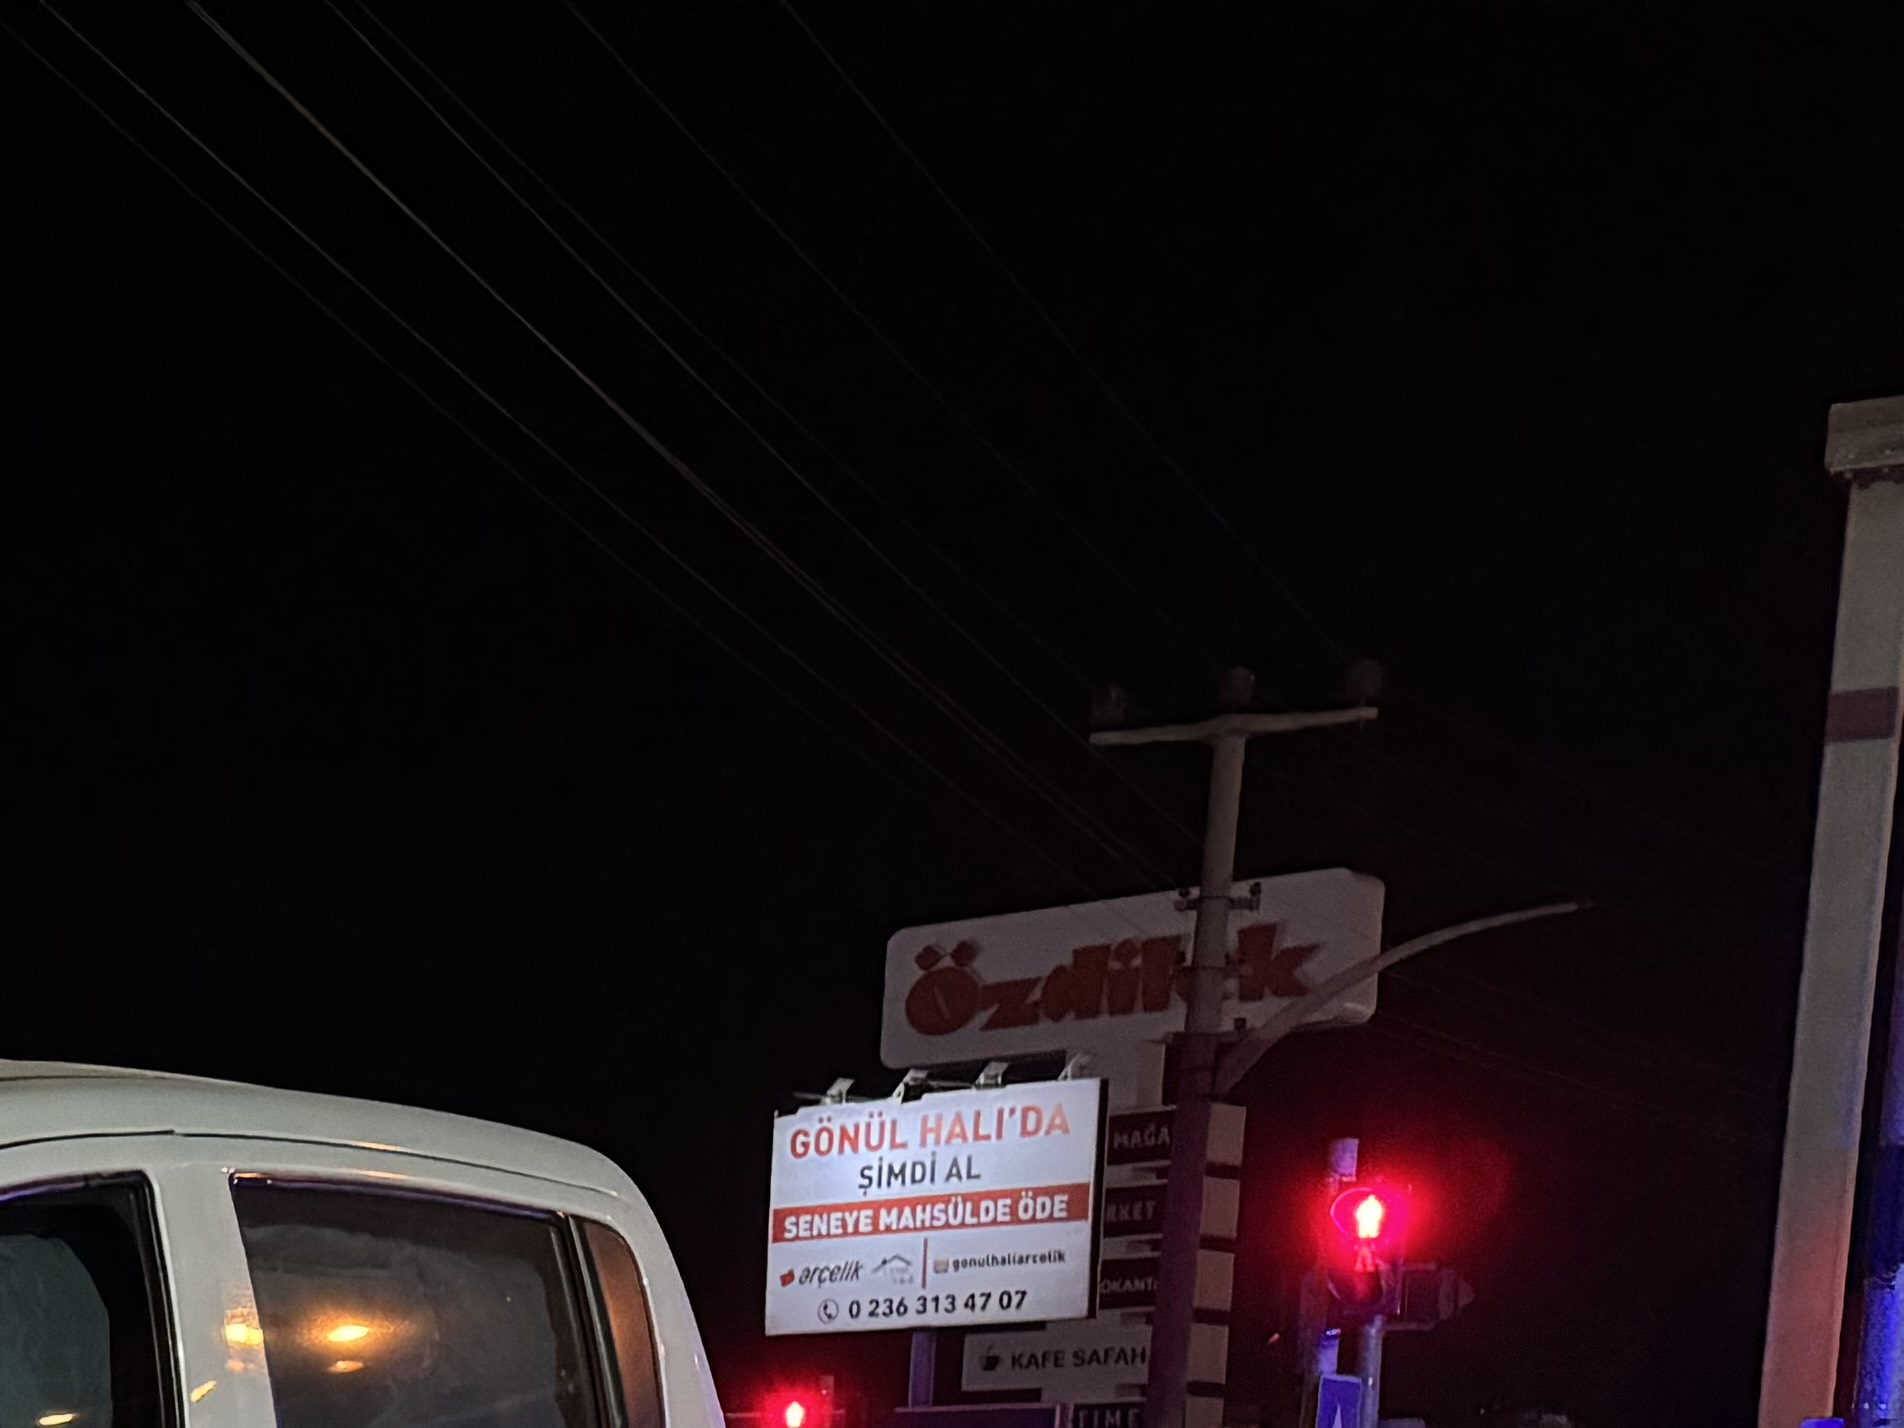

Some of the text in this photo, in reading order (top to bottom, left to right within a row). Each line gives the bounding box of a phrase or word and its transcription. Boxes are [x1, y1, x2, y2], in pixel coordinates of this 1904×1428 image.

[905, 922, 1325, 1036] Özdilk
[790, 1103, 1070, 1159] GÖNÜL HALI'DA
[857, 1151, 981, 1196] ŞİMDİ AL
[784, 1190, 1068, 1240] SENEYE MAHSÜLDE ÖDE
[798, 1260, 864, 1289] arçelik
[1101, 1276, 1158, 1294] OKANT
[848, 1290, 1028, 1320] 0 236 313 47 07
[1010, 1351, 1065, 1370] KAFE
